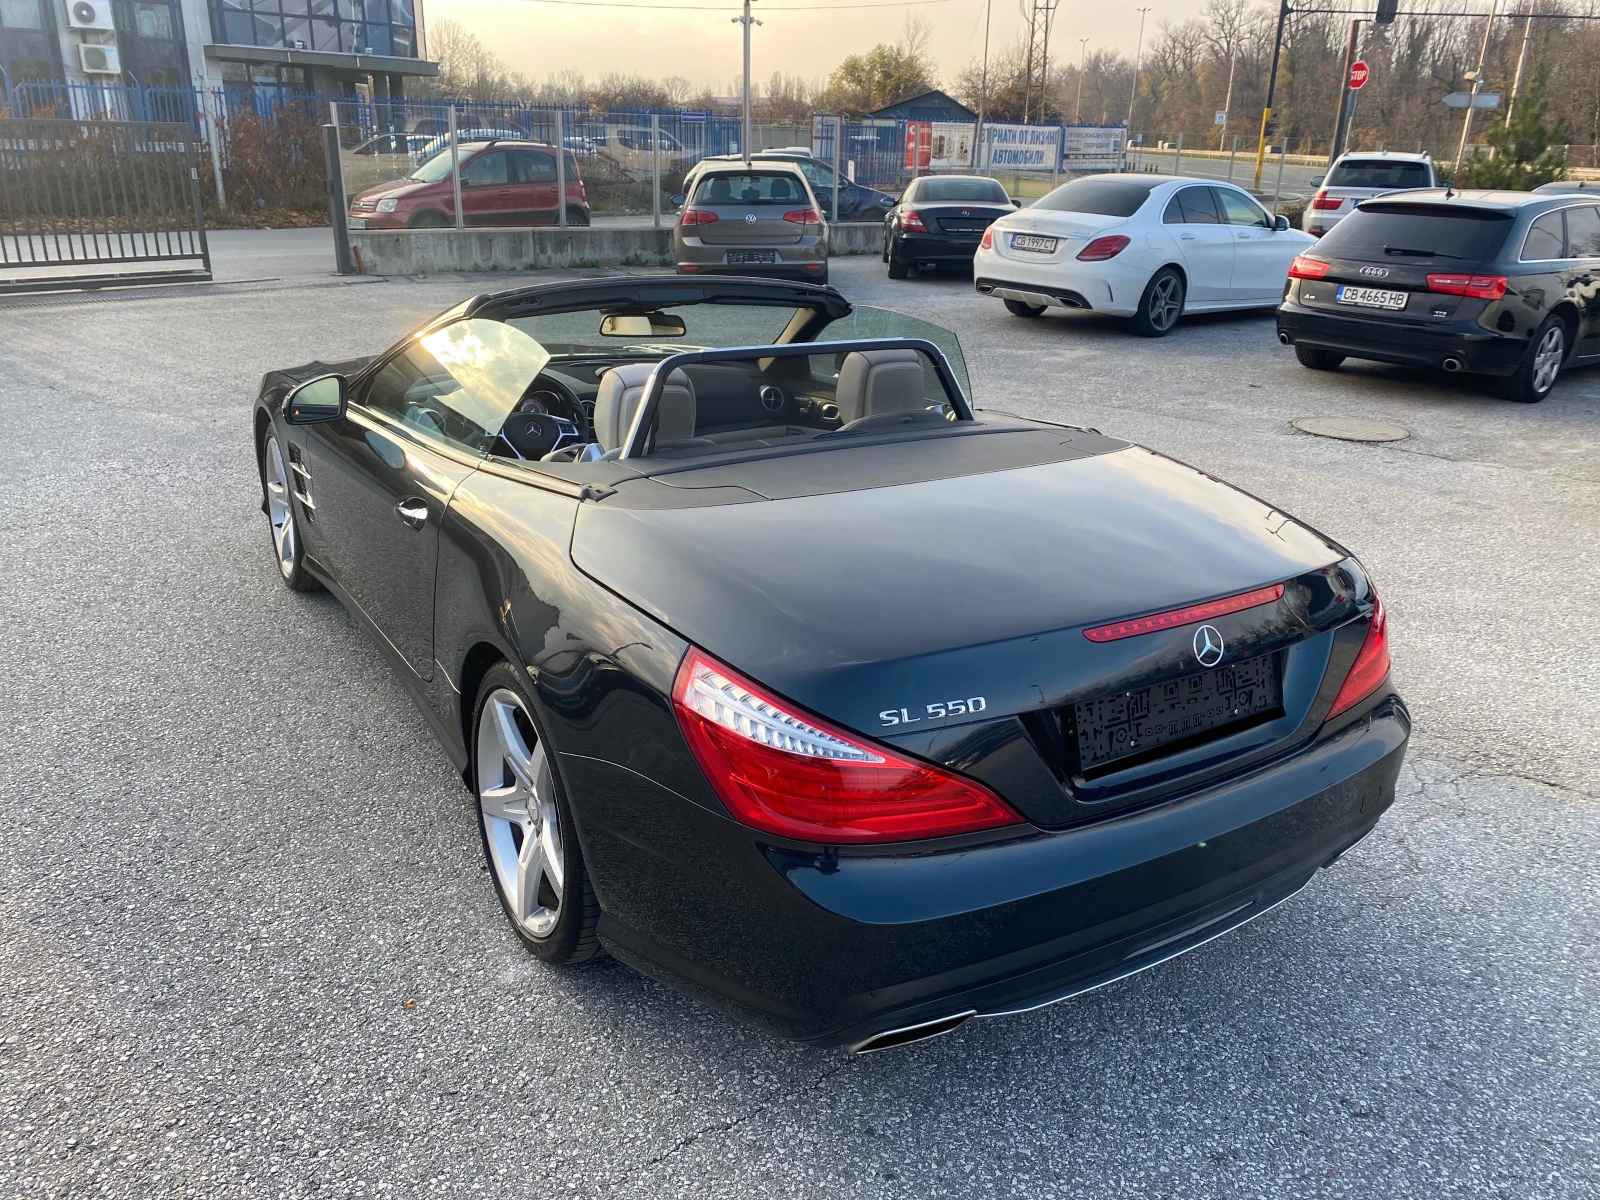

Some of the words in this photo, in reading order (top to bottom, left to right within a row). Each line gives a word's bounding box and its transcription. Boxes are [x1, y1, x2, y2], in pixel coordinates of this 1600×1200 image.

[1020, 129, 1029, 144] ОТ
[992, 148, 1044, 164] АВТОМОБИЛИ
[1016, 236, 1026, 246] CB
[1028, 237, 1044, 247] 1997
[1044, 239, 1056, 249] CT
[1343, 288, 1358, 300] CB
[1360, 291, 1387, 304] 4665
[1387, 293, 1405, 306] HB
[879, 707, 921, 727] SL
[925, 695, 986, 720] 550
